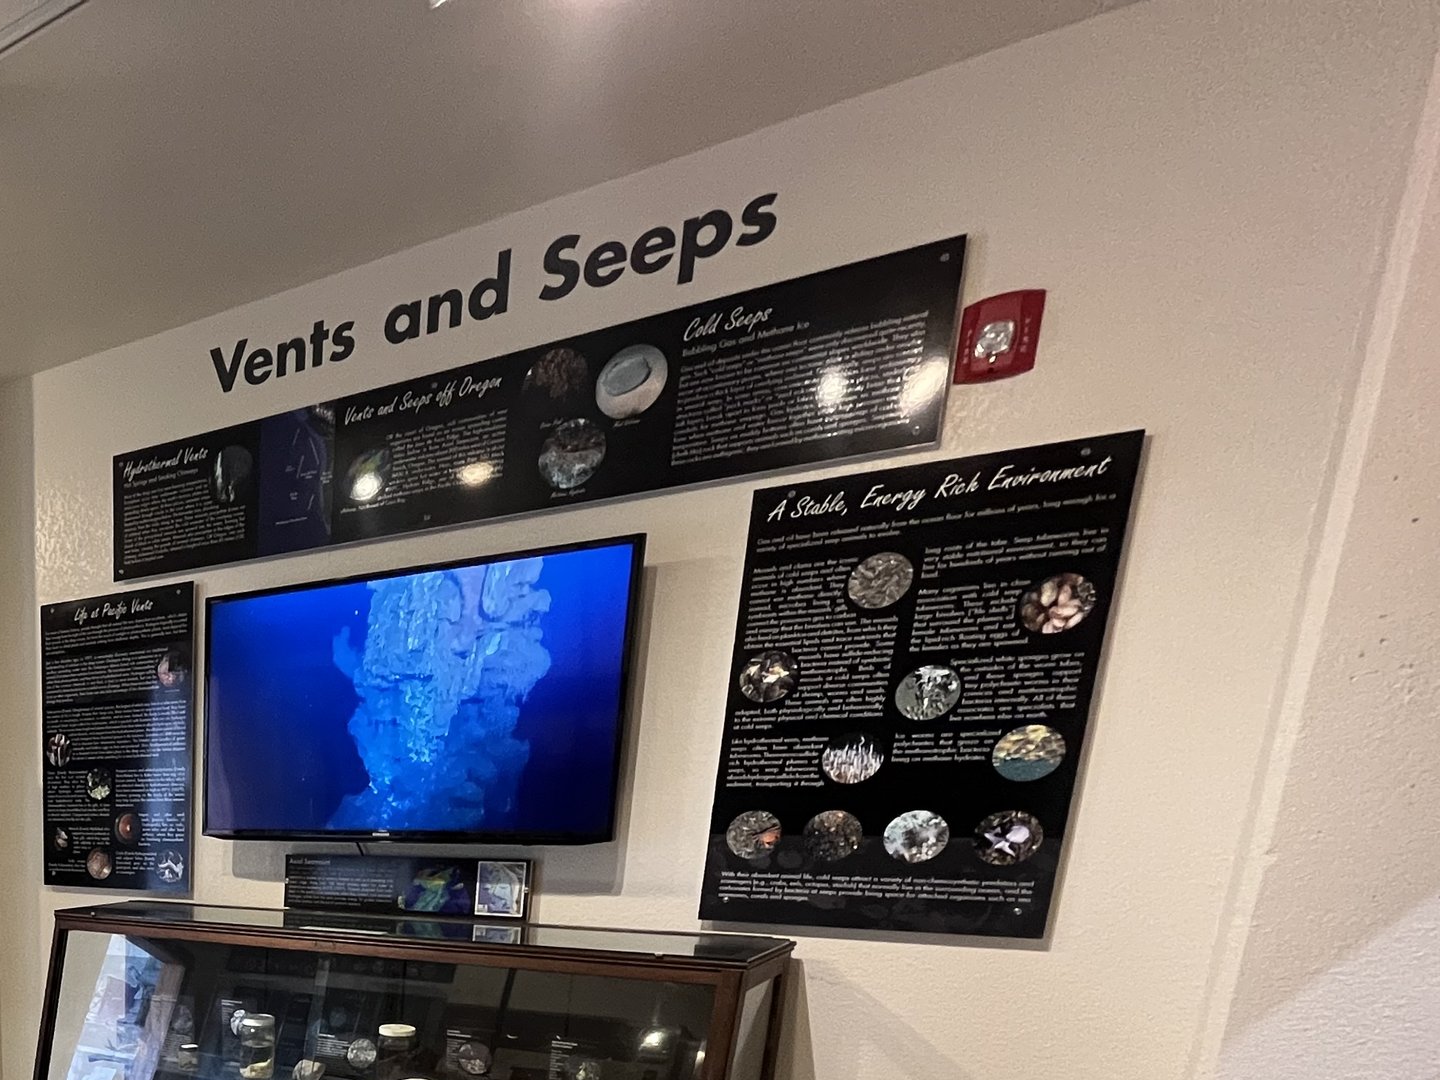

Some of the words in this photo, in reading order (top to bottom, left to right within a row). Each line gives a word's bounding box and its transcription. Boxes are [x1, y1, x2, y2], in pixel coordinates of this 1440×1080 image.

[210, 320, 354, 392] Vents
[384, 248, 511, 344] and
[539, 193, 777, 300] Seeps
[683, 308, 720, 343] Cold
[724, 305, 773, 335] Seeps
[344, 405, 374, 426] Vents
[377, 396, 396, 415] and
[399, 391, 430, 415] Seeps
[434, 380, 457, 408] off
[458, 374, 502, 403] Oregon
[183, 446, 210, 467] Vents
[767, 499, 786, 523] A
[790, 491, 849, 517] Stable,
[860, 483, 926, 511] Energy
[934, 470, 979, 499] Rich
[987, 455, 1113, 491] Environment
[73, 607, 88, 626] Life
[101, 601, 128, 620] Pacific
[131, 597, 154, 614] Vents
